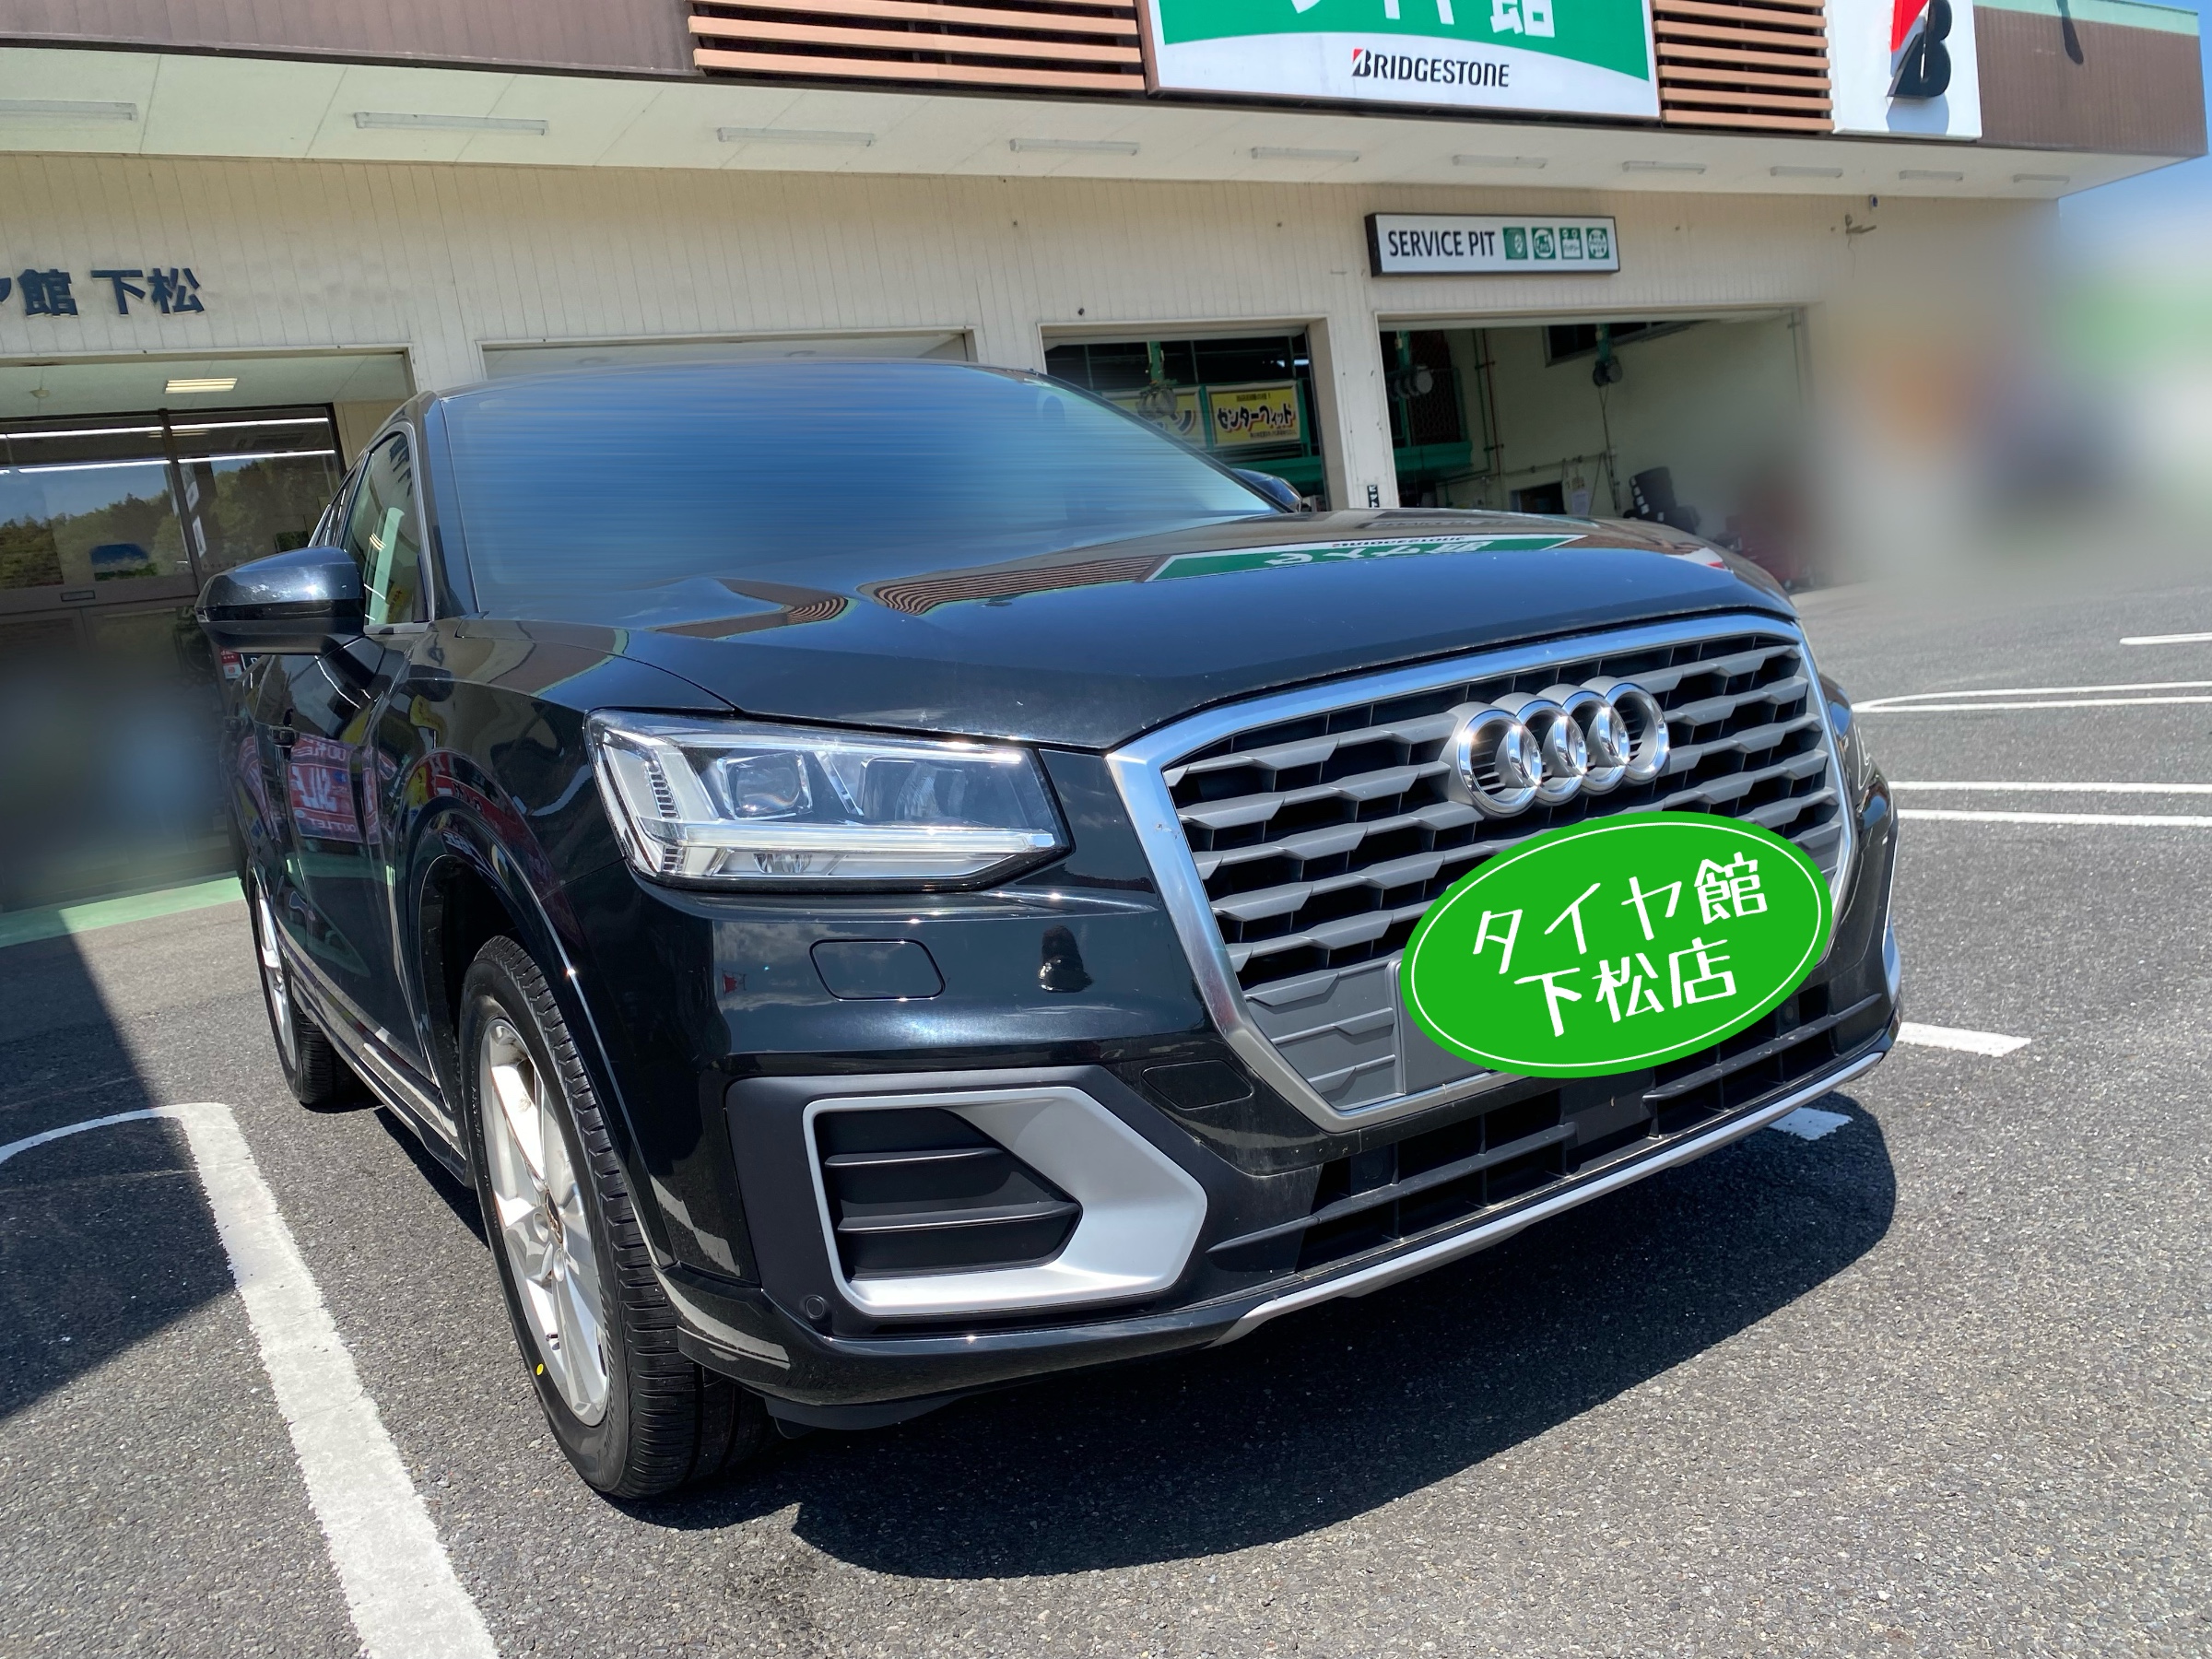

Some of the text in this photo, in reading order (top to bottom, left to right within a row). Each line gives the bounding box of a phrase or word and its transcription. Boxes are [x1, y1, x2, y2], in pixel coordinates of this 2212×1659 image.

[1352, 48, 1510, 88] BRIDGESTONE
[1387, 229, 1495, 257] SERVICE PIT
[0, 267, 205, 316] 館 下松
